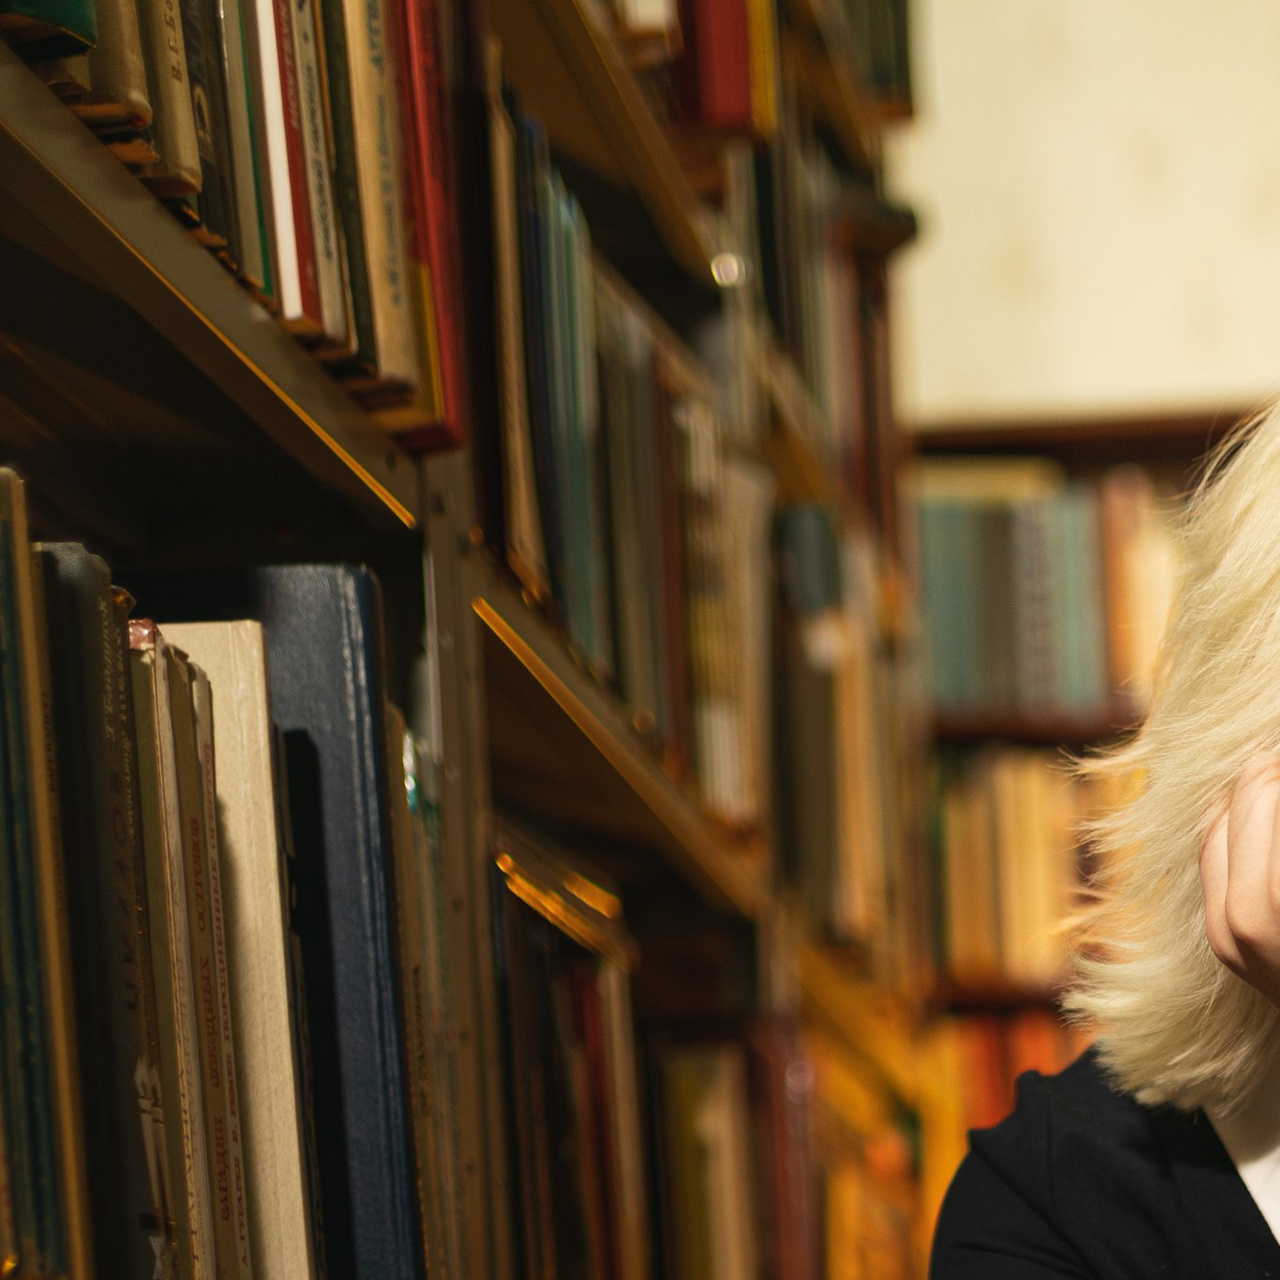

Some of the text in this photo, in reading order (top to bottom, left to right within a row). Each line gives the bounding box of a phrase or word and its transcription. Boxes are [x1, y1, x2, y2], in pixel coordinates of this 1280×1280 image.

[190, 817, 231, 1222] ЗАГАДКИ ЗВЕЗДНЫХ ОСТРОВОВ
